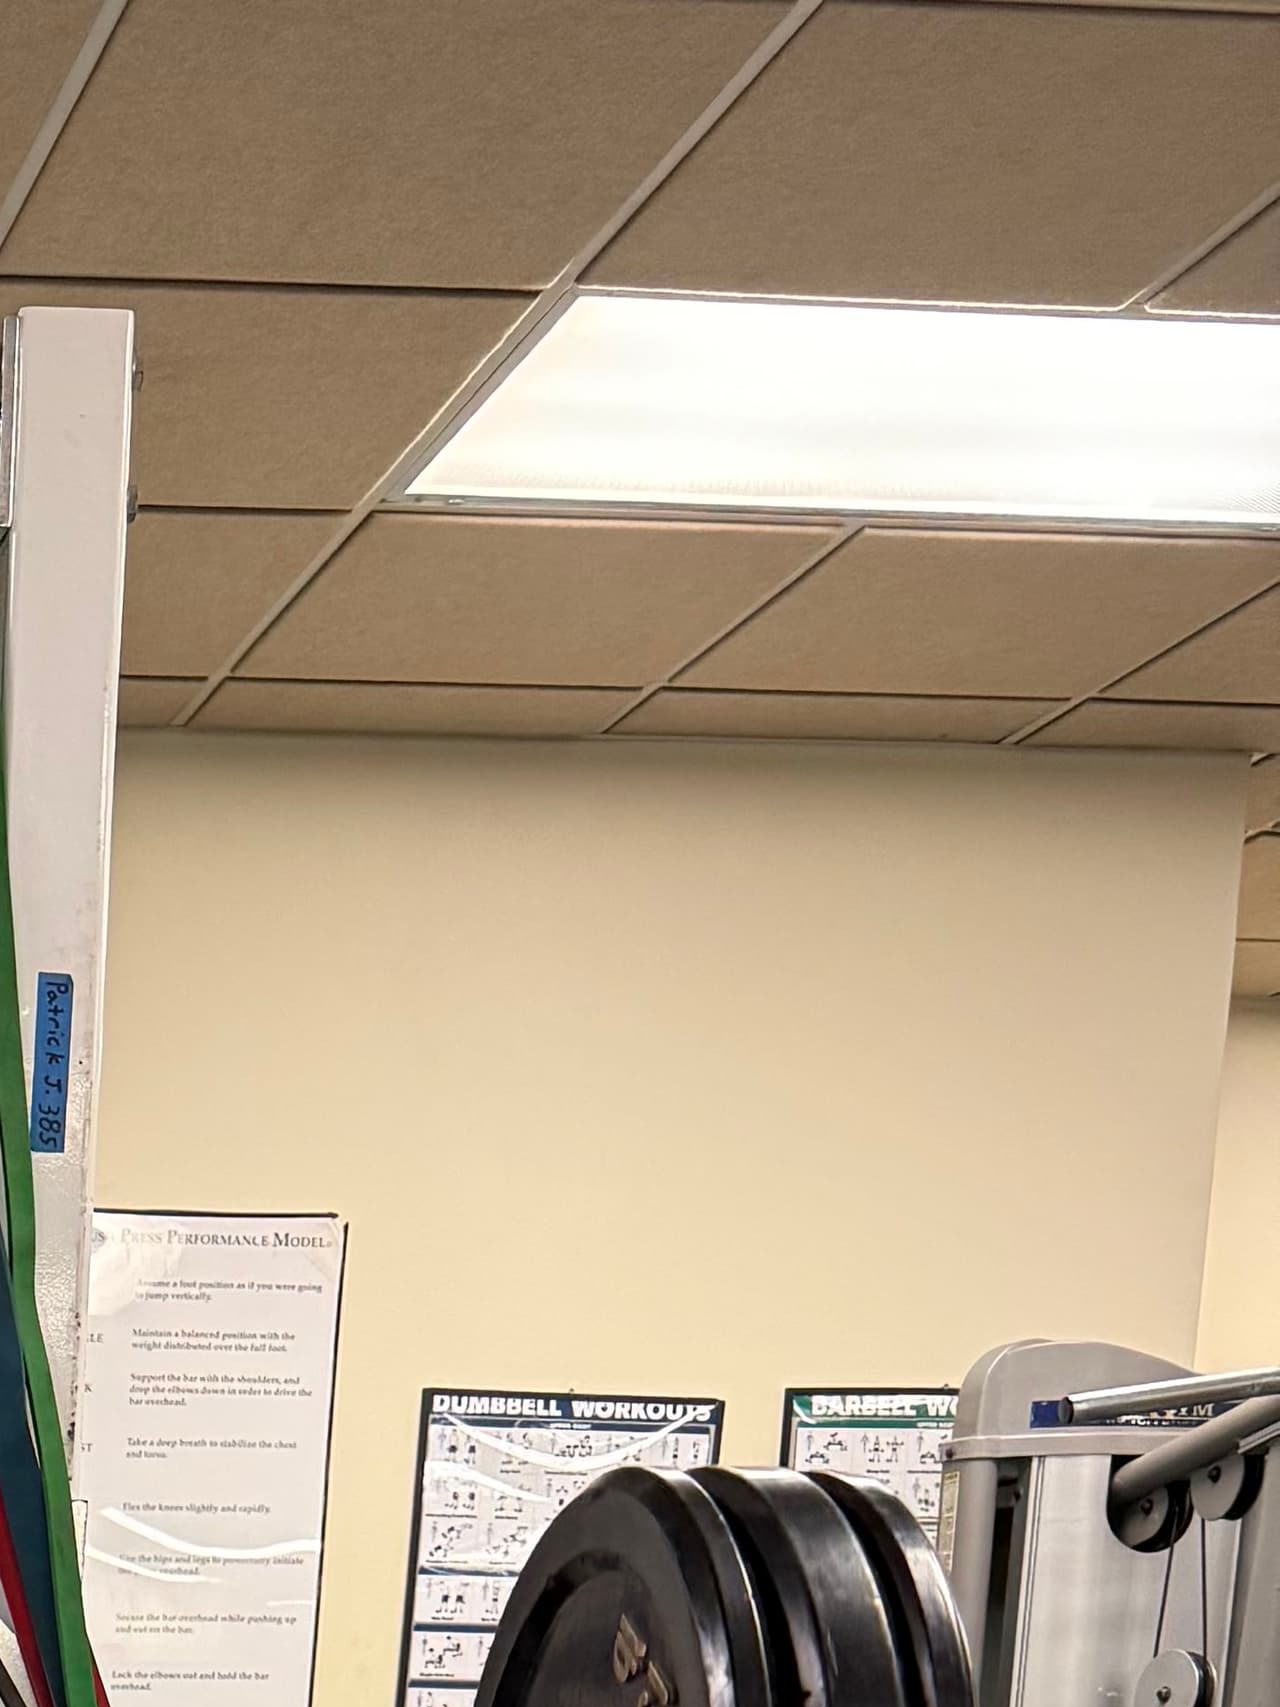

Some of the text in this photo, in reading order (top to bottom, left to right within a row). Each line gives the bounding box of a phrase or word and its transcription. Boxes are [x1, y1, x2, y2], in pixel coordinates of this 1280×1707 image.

[45, 981, 69, 1065] Patrick
[39, 1103, 61, 1148] 385
[432, 1394, 562, 1417] DUMBBELL
